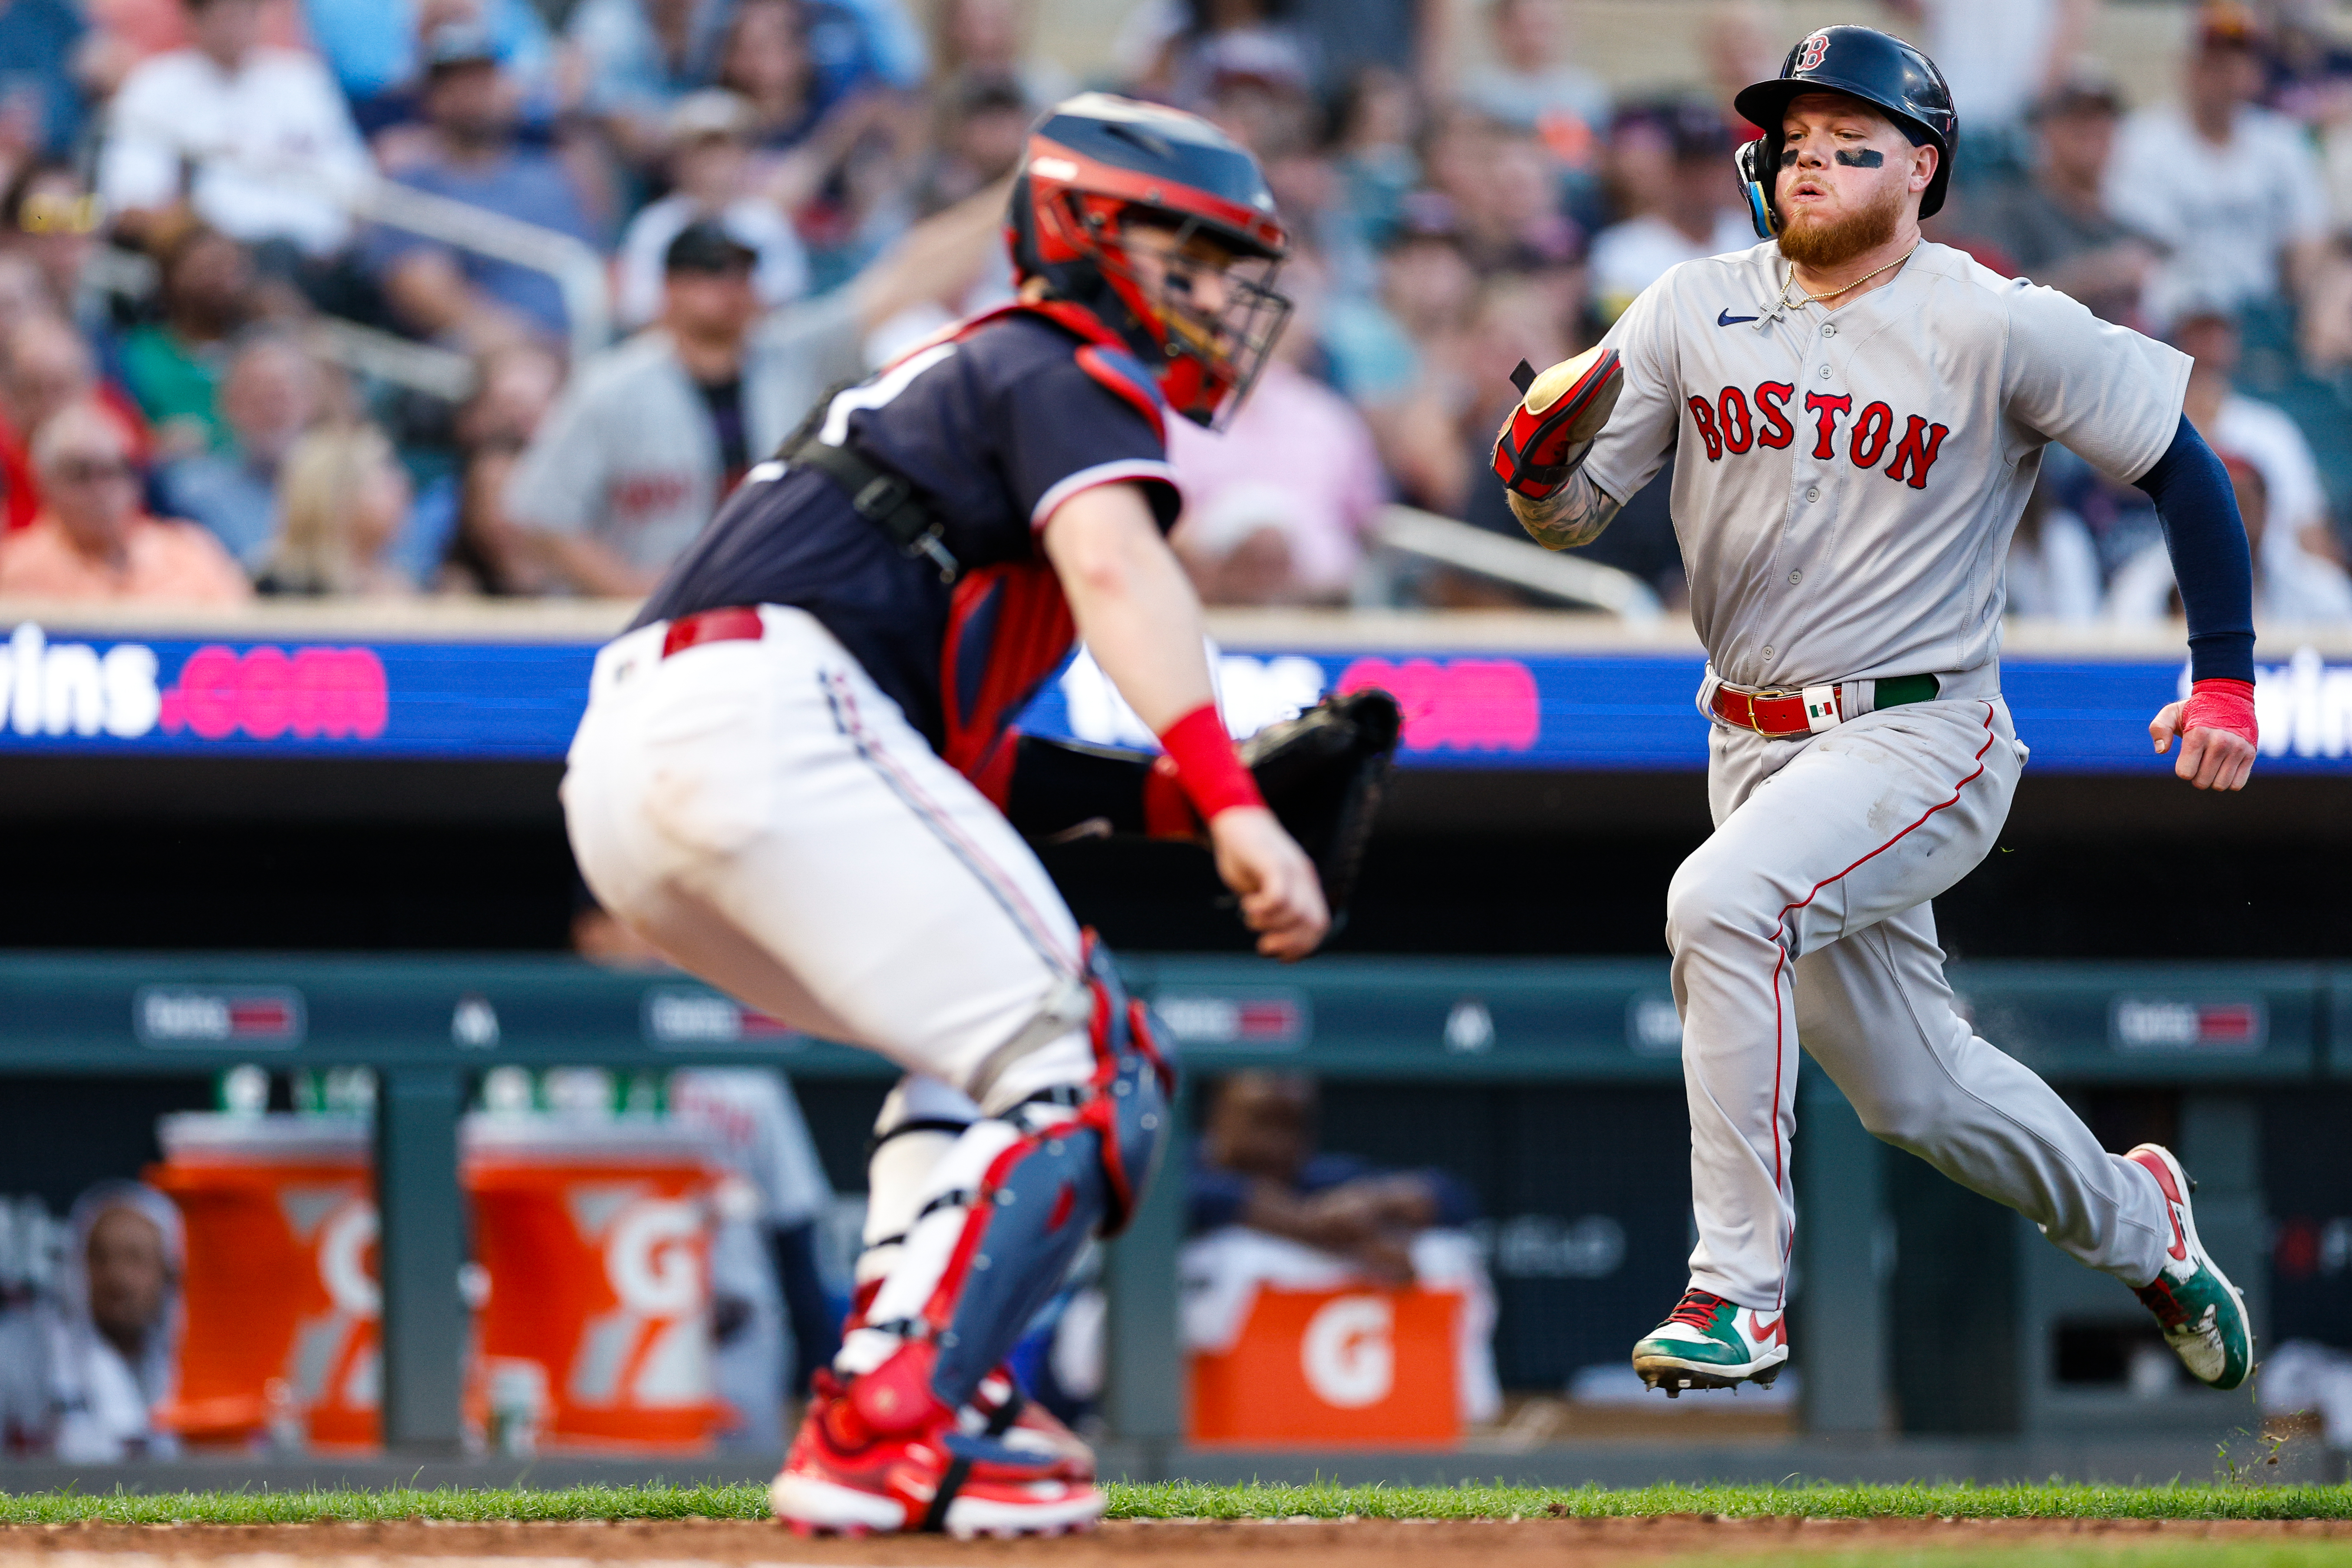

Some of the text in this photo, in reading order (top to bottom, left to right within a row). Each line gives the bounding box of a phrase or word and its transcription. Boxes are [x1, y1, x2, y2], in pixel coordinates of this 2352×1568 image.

[1797, 35, 1831, 72] B
[1687, 380, 1950, 490] BOSTON
[607, 1198, 701, 1314] G
[1300, 1293, 1397, 1411] G
